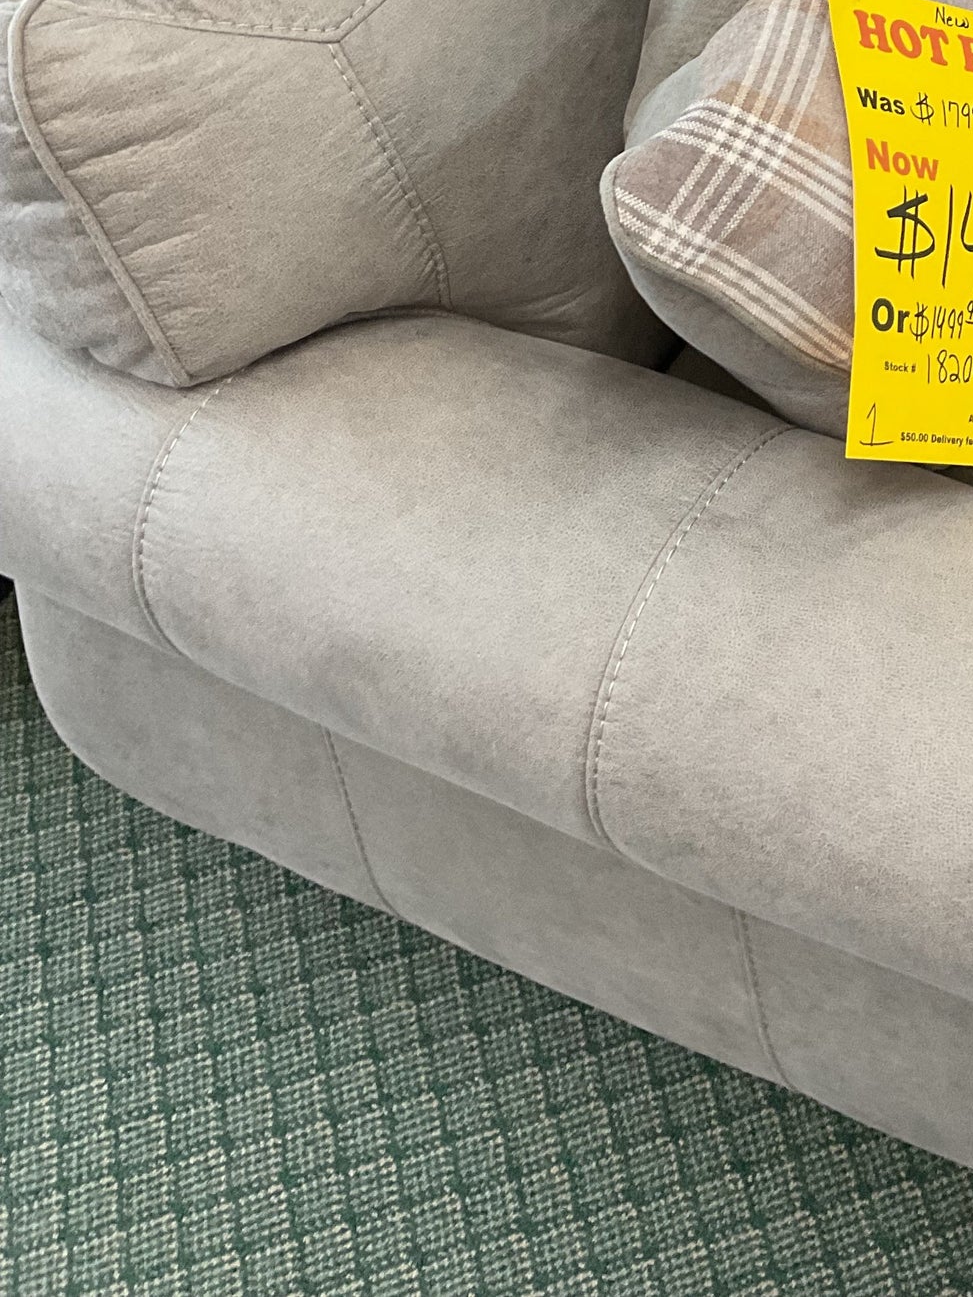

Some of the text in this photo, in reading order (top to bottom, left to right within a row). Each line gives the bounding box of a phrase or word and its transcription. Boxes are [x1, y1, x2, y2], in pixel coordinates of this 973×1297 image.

[935, 6, 970, 29] New
[853, 9, 949, 66] HOT
[856, 86, 906, 115] Was
[865, 137, 939, 181] Now
[871, 297, 910, 333] Or
[884, 360, 909, 373] Stock
[900, 431, 929, 443] $50.00
[931, 434, 964, 447] Delivery
